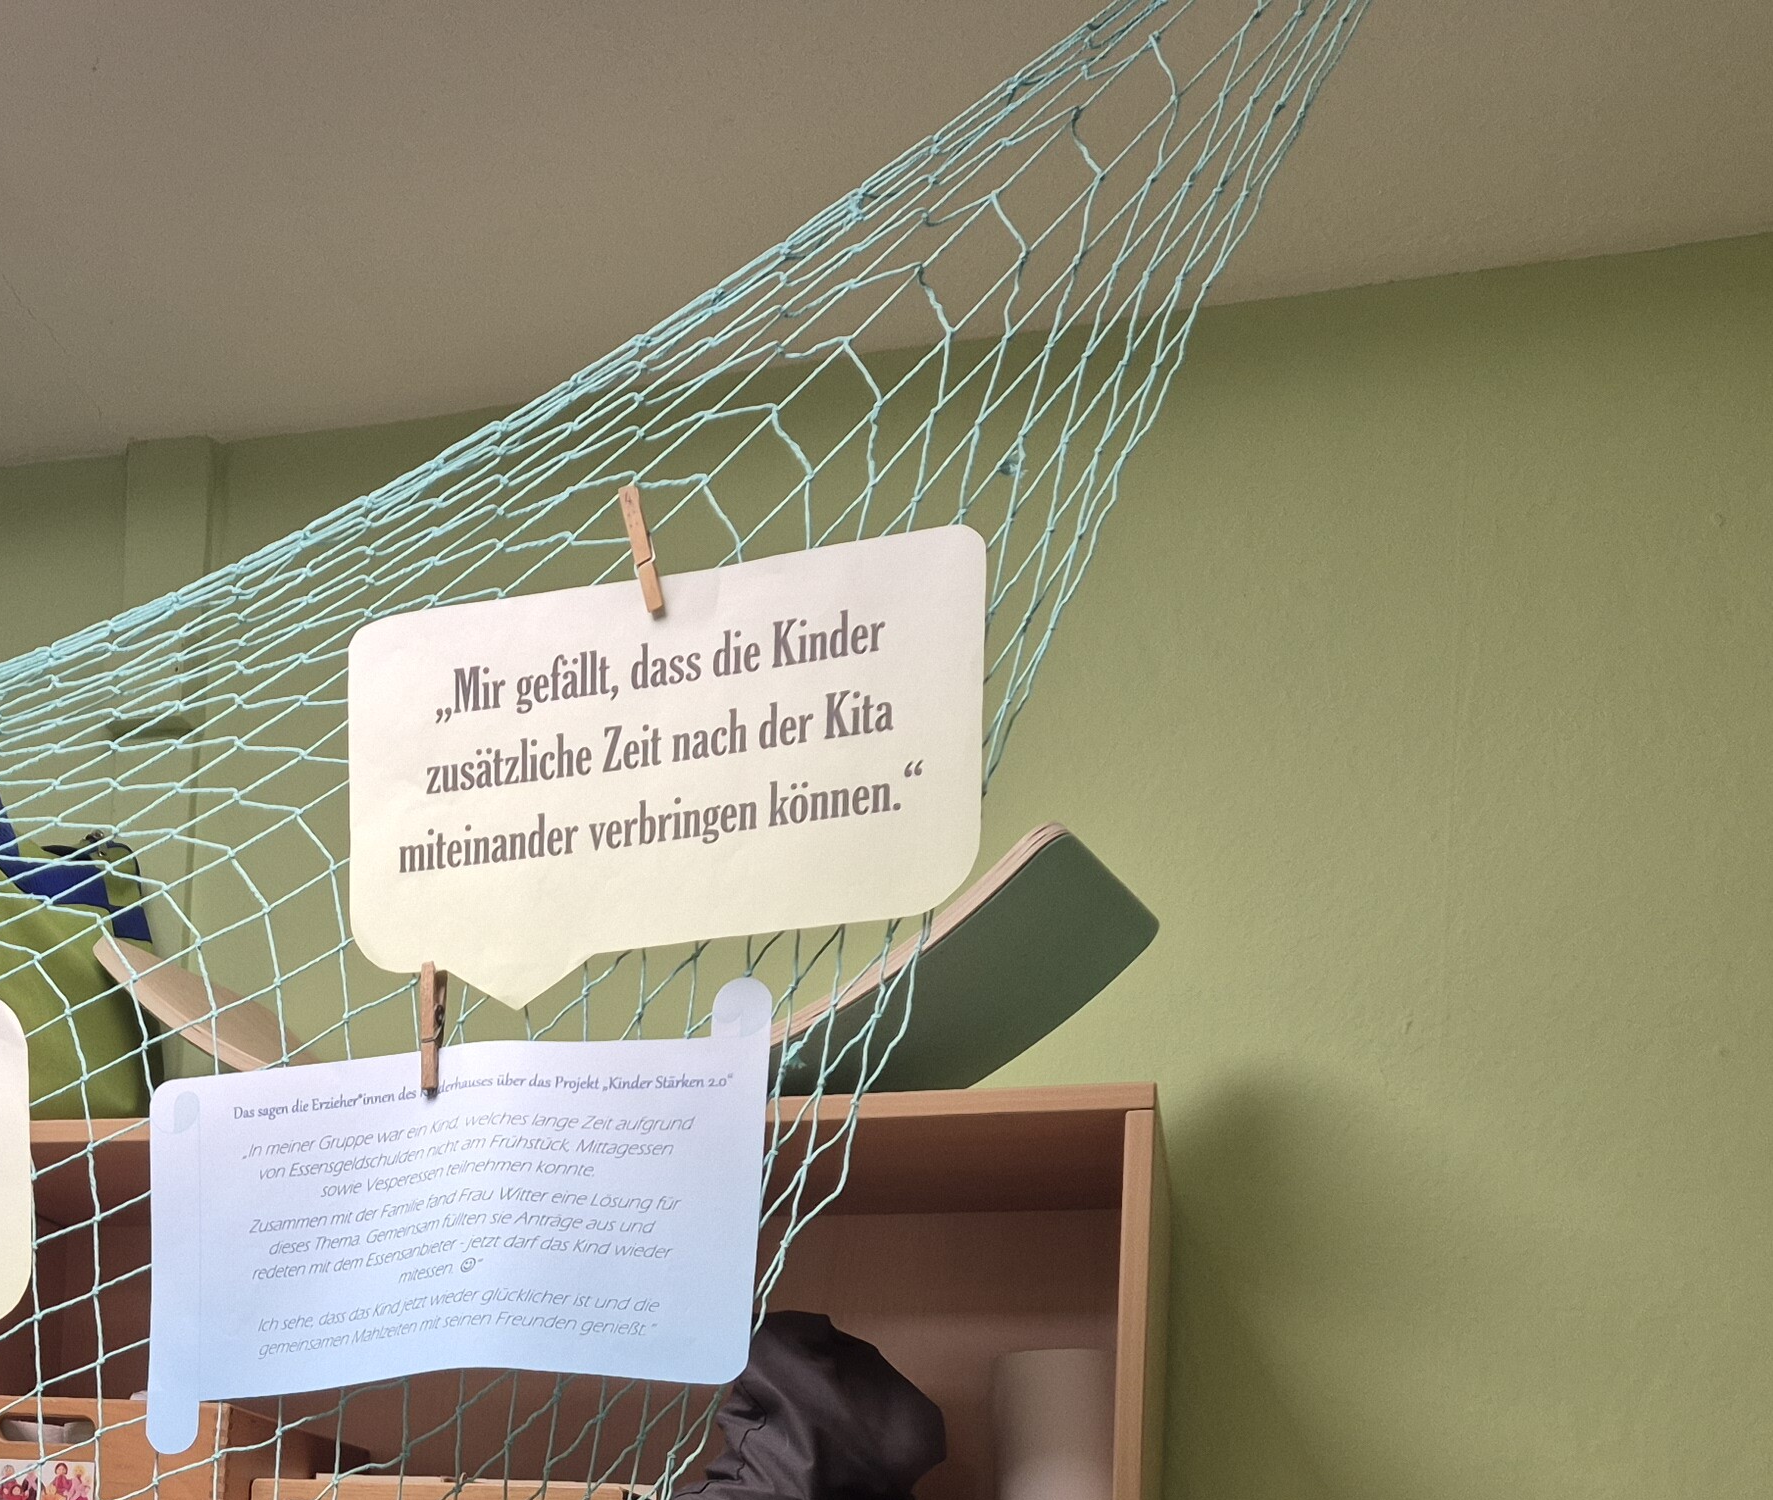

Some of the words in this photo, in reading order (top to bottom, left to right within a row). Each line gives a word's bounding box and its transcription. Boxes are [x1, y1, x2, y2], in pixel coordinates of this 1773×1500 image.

[436, 666, 505, 723] „Mir
[517, 650, 618, 714] gefällt,
[631, 643, 701, 689] dass
[713, 630, 760, 677] die
[772, 610, 885, 668] Kinder
[427, 733, 592, 794] zusätzliche
[603, 725, 661, 772] Zeit
[672, 708, 747, 762] nach
[759, 702, 813, 749] der
[825, 690, 893, 739] Kita
[400, 813, 578, 873] miteinander
[589, 797, 756, 850] verbringen
[769, 760, 923, 827] können.“
[234, 1107, 254, 1119] Das
[258, 1106, 288, 1120] sagen
[292, 1099, 309, 1113] die
[398, 1086, 416, 1100] des
[497, 1073, 526, 1086] über
[529, 1074, 550, 1087] das
[555, 1075, 599, 1093] Projekt
[603, 1075, 653, 1091] „Kinder
[655, 1074, 704, 1088] Stärken
